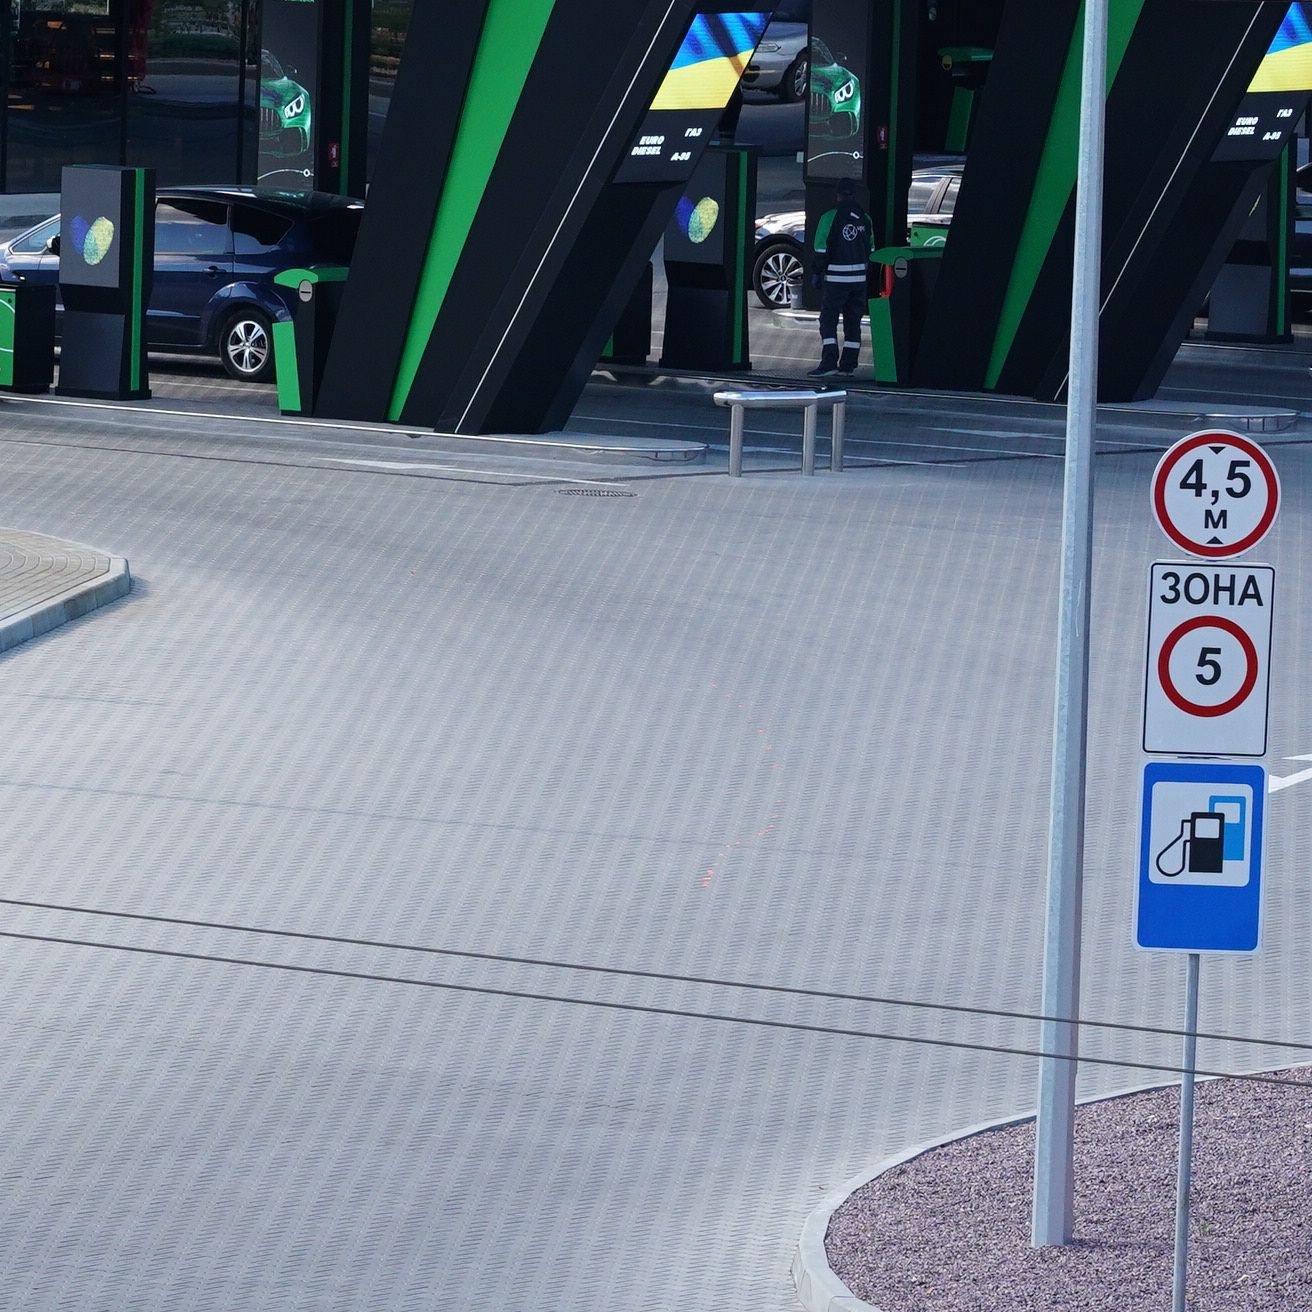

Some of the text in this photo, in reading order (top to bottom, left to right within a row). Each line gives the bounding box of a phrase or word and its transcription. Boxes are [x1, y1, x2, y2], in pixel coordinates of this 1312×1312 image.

[631, 146, 662, 156] DIESEL
[639, 135, 665, 145] EURO
[1179, 458, 1252, 506] 4,5
[1160, 572, 1264, 607] ЗОНА
[1195, 647, 1222, 686] 5
